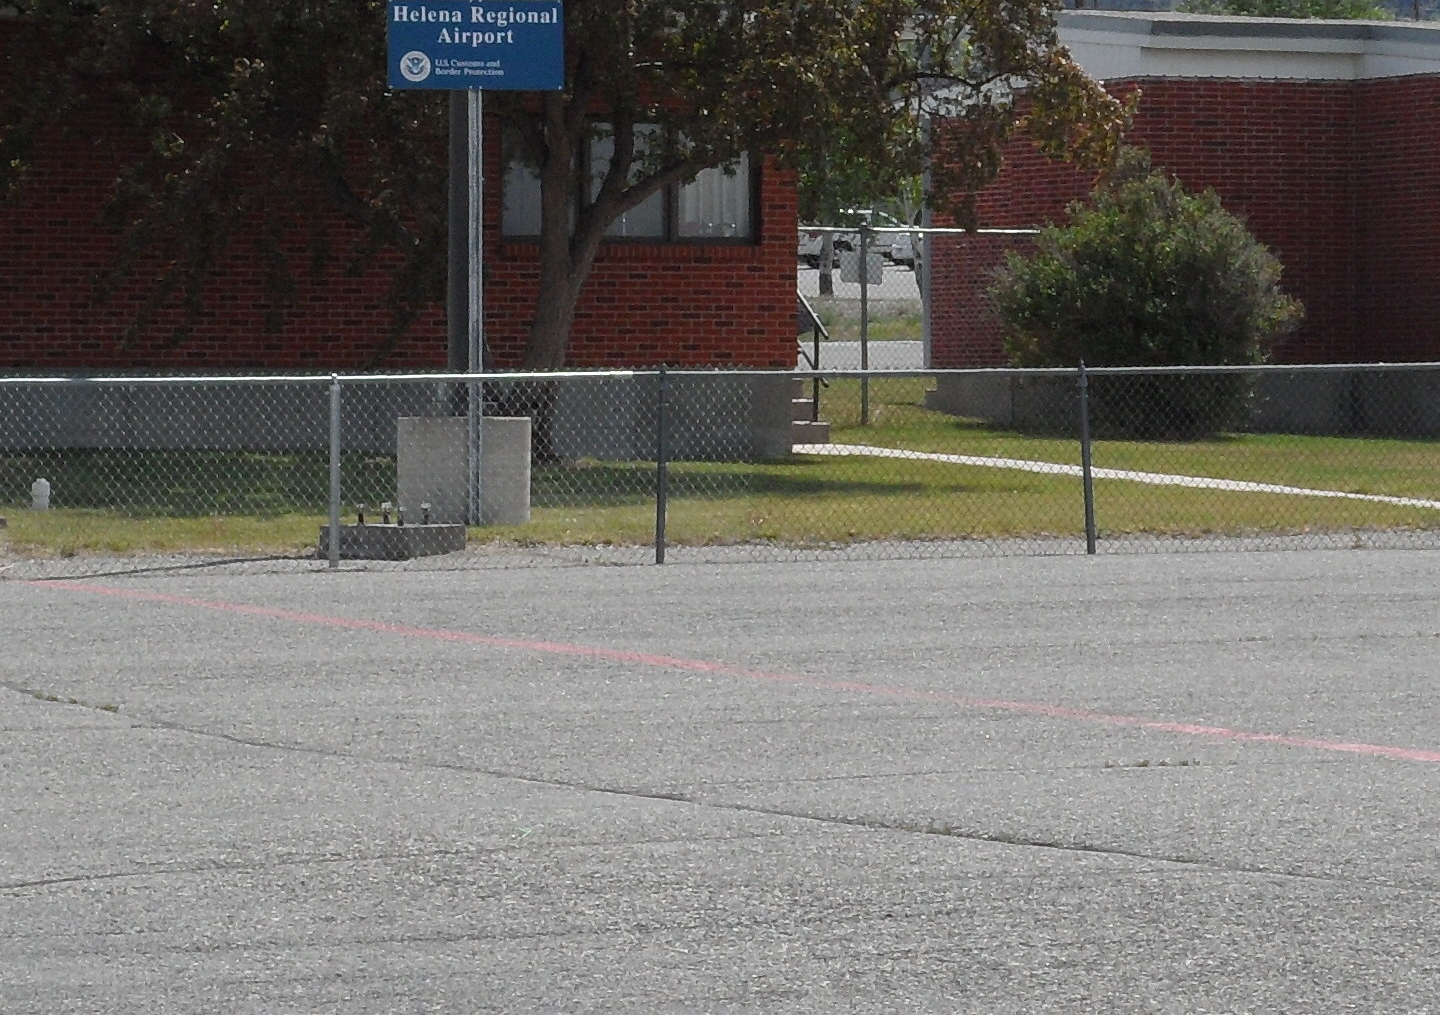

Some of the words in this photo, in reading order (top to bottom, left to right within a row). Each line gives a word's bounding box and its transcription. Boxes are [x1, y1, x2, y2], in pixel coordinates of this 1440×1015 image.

[393, 5, 462, 22] Helena
[470, 6, 558, 27] Regional
[437, 28, 514, 47] Airport
[450, 59, 484, 67] Customs
[485, 59, 500, 67] and
[435, 68, 461, 76] Border
[463, 68, 504, 76] Protection
